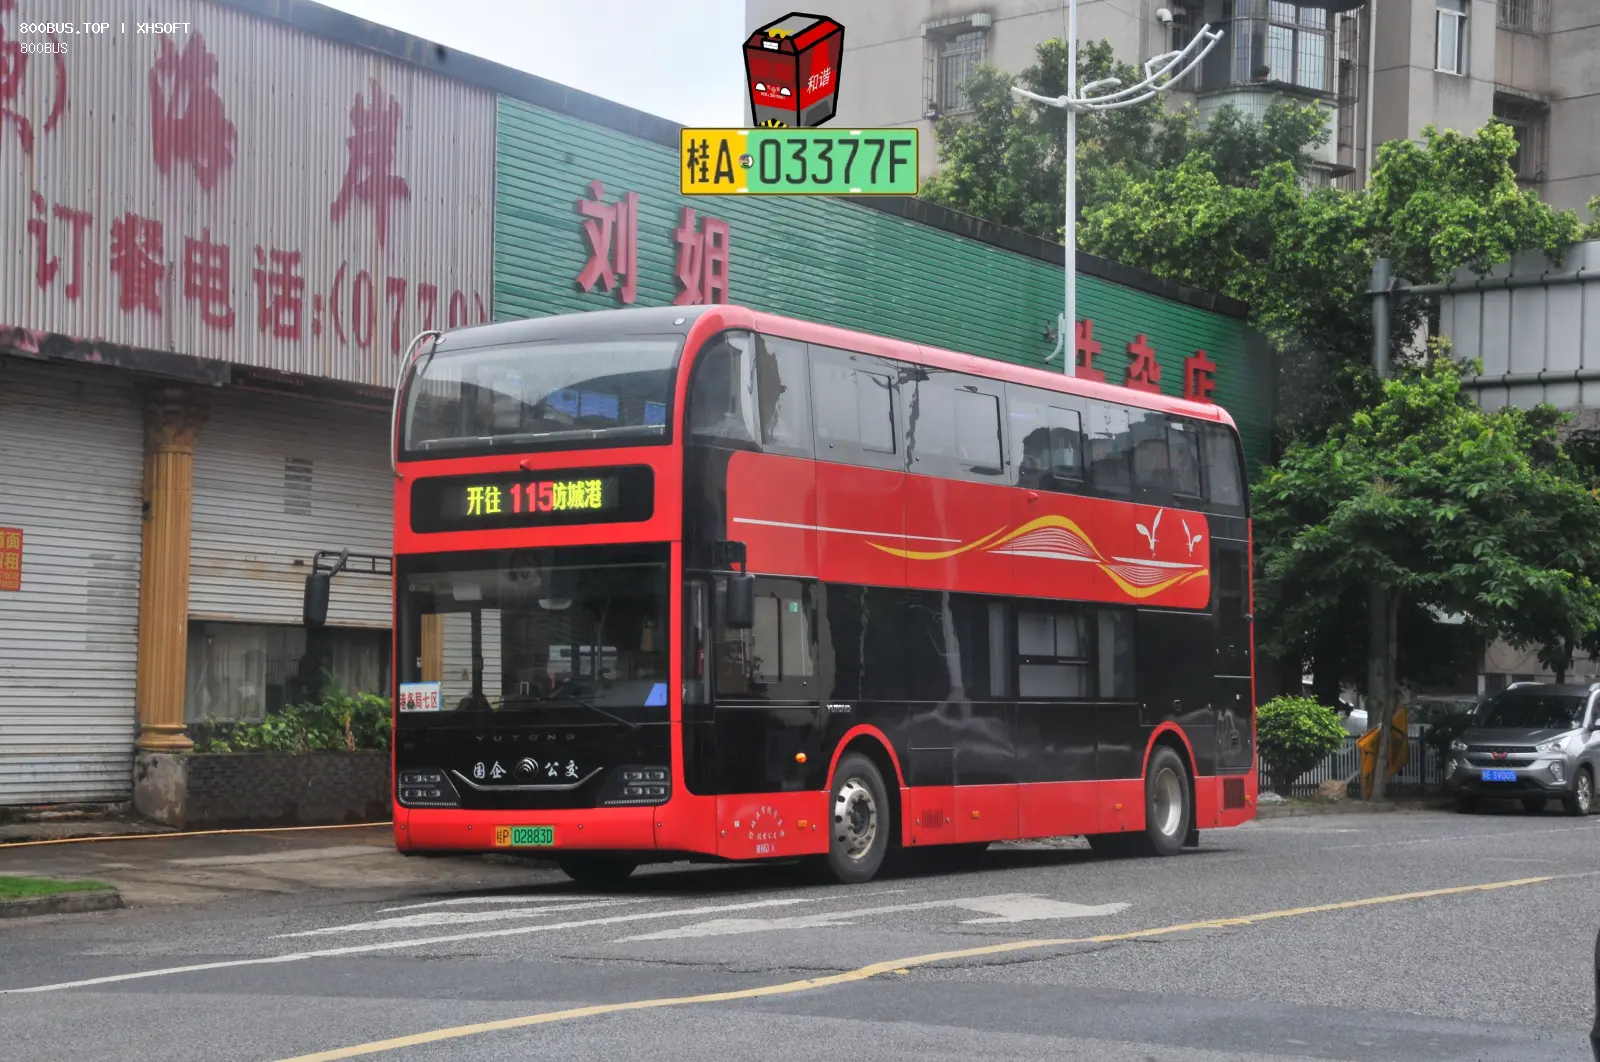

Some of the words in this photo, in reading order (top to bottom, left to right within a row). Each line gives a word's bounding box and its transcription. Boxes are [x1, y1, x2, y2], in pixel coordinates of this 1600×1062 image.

[576, 179, 730, 306] 刘姐
[466, 486, 502, 515] 开往
[510, 482, 554, 513] 115
[552, 480, 602, 511] 防城港
[473, 761, 507, 779] 国企
[544, 759, 579, 779] 公交
[513, 828, 553, 844] 02883D
